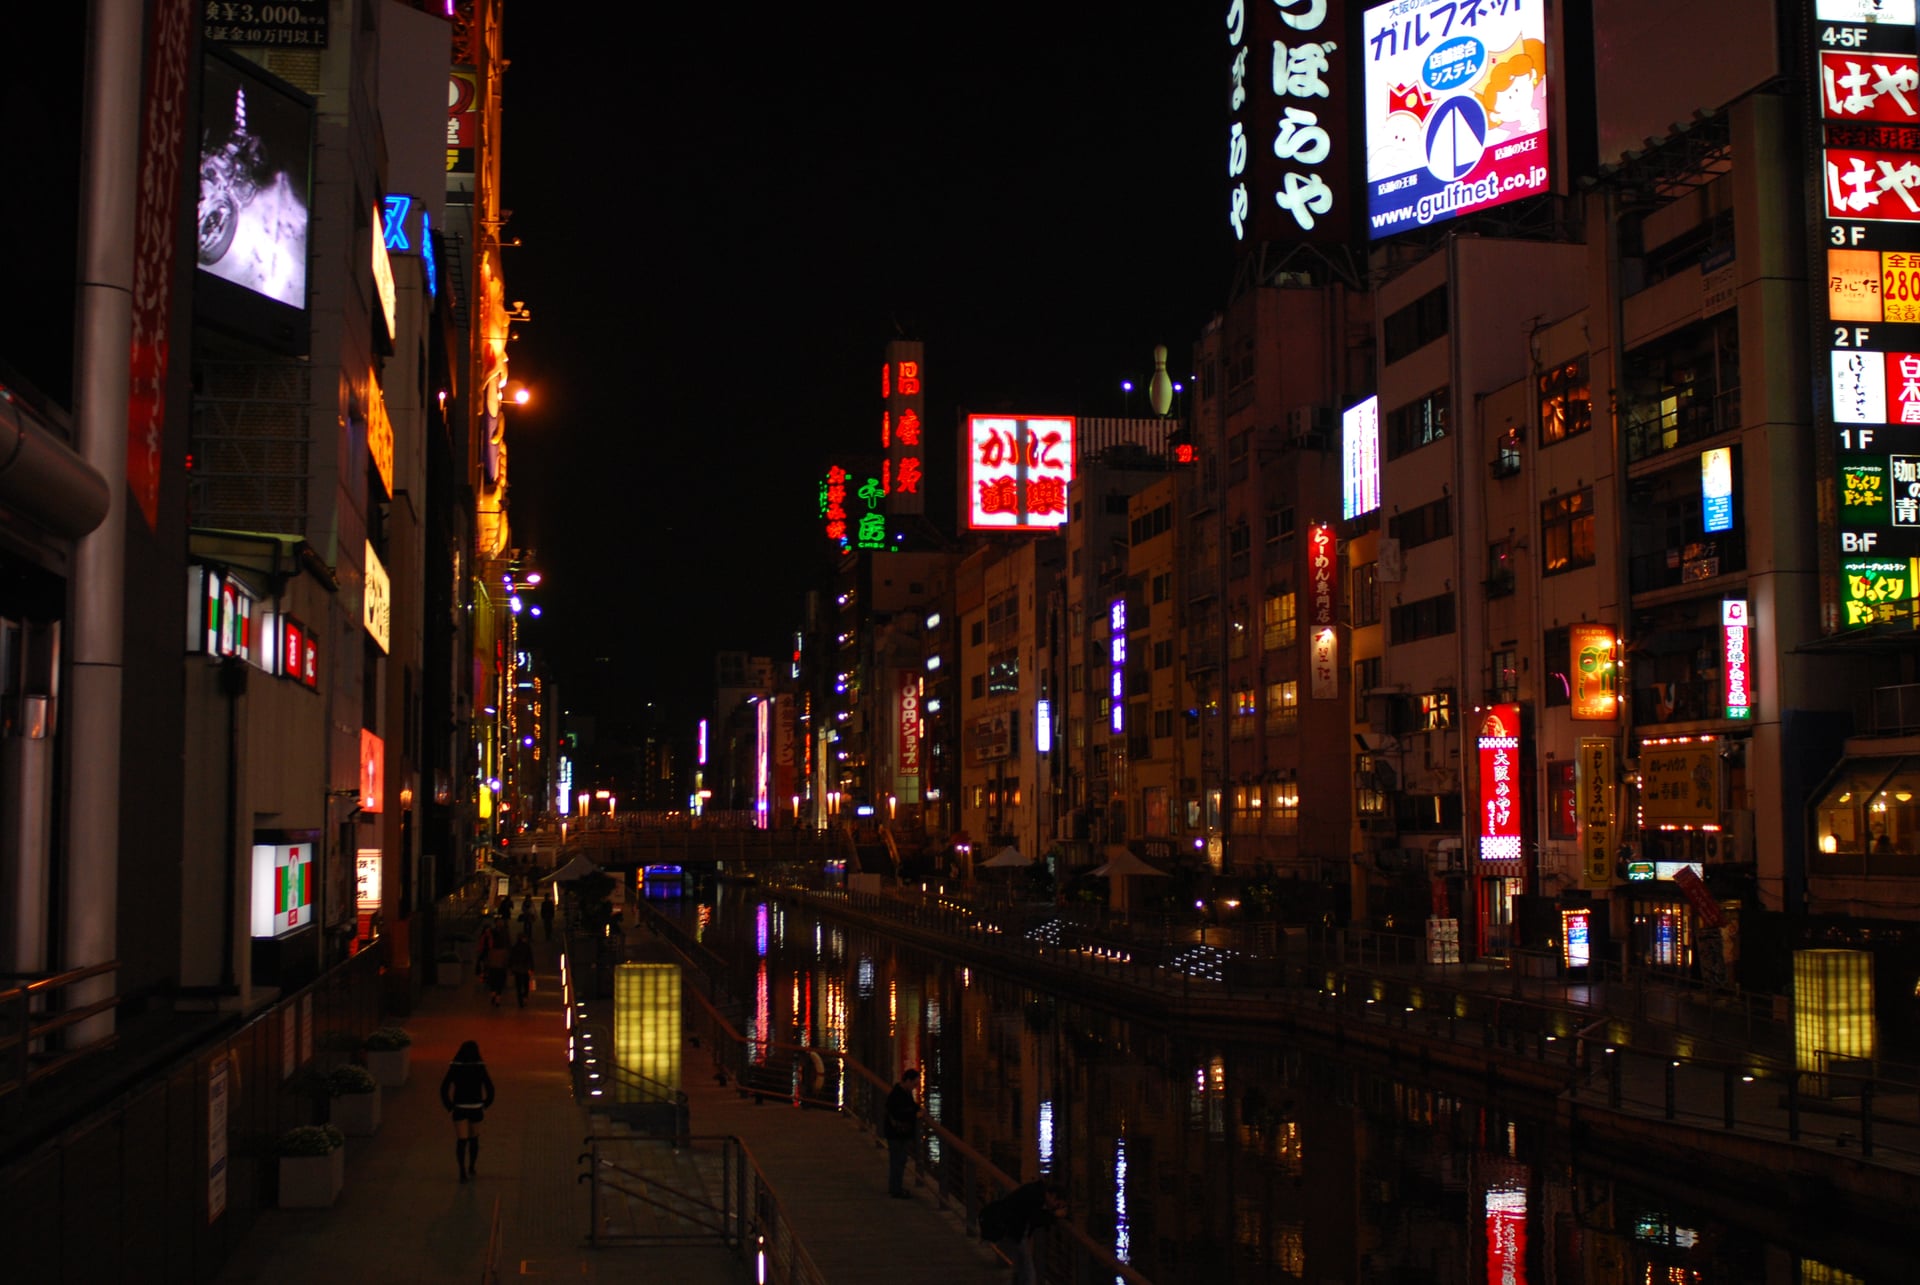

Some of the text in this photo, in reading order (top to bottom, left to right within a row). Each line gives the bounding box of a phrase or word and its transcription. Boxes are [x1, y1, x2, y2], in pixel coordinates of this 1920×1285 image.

[1370, 0, 1521, 62] ガルフネッ
[1430, 60, 1478, 87] システム
[1823, 61, 1920, 116] はや
[1371, 165, 1547, 225] www.gulfnet.co.jp
[1828, 157, 1920, 213] はや
[1831, 226, 1866, 246] 3F
[1834, 327, 1870, 347] 2F
[1898, 354, 1920, 424] 白木屋
[978, 427, 1064, 470] かに
[1840, 429, 1874, 450] 1F
[1845, 473, 1881, 491] びっくり
[1893, 460, 1920, 482] 珈
[1843, 489, 1883, 506] ドンキー
[1895, 497, 1920, 523] 青
[1841, 532, 1878, 553] B1F
[1314, 527, 1331, 623] らーめん専門店
[1845, 563, 1907, 572] ハンバーグレストラン
[1848, 574, 1905, 601] びっくり
[1846, 600, 1910, 625] ドンキー
[1494, 748, 1511, 826] 大阪みやげ
